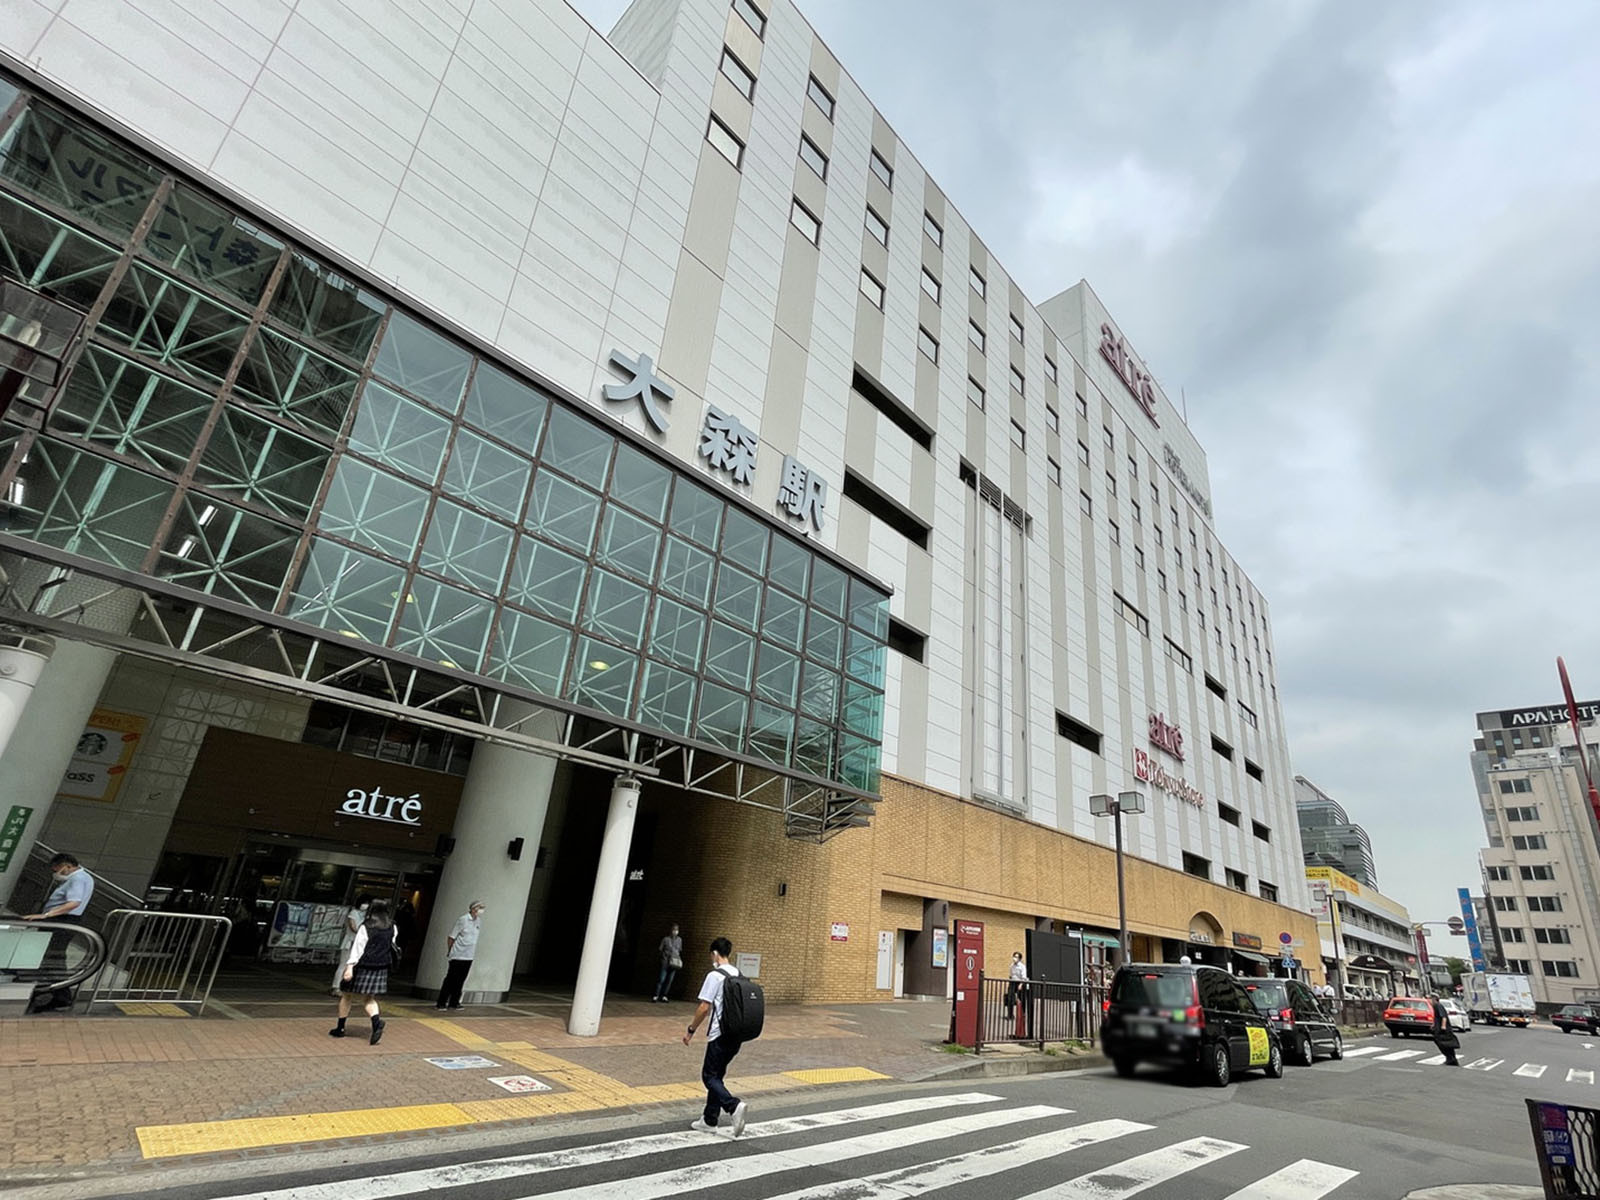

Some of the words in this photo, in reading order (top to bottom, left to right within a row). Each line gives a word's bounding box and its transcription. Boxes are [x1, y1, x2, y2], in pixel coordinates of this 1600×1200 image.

[1099, 324, 1160, 429] atré
[603, 349, 828, 531] 大森駅
[1512, 711, 1549, 725] APA
[64, 769, 96, 783] ass
[337, 785, 423, 826] atré
